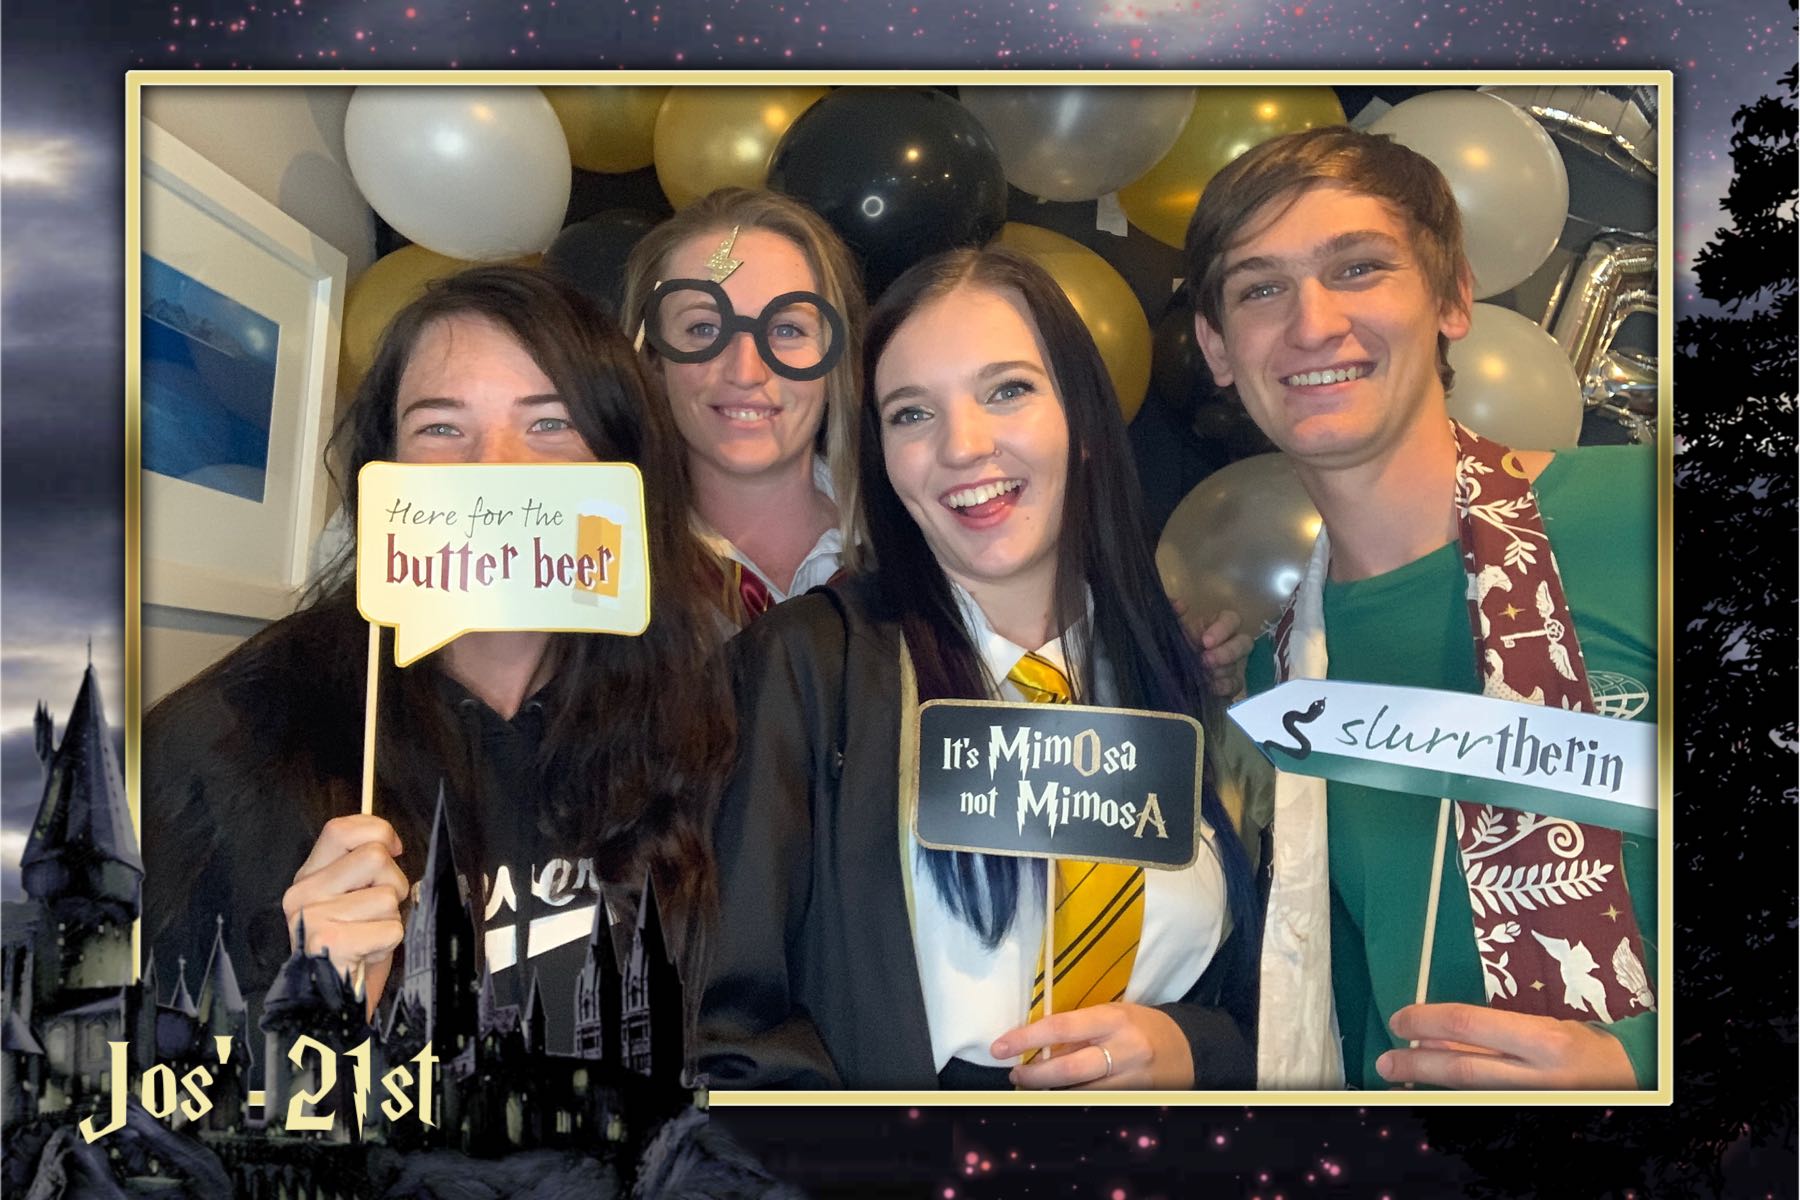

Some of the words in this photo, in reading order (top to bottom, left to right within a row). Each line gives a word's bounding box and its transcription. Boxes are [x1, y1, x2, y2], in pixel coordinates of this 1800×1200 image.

[385, 498, 458, 526] Here
[468, 496, 513, 538] for
[523, 498, 564, 528] the
[385, 533, 519, 592] butter
[533, 537, 614, 590] beer
[942, 737, 980, 770] It's
[988, 725, 1137, 781] MimOsa
[960, 787, 998, 818] not
[1017, 780, 1168, 839] MimosA
